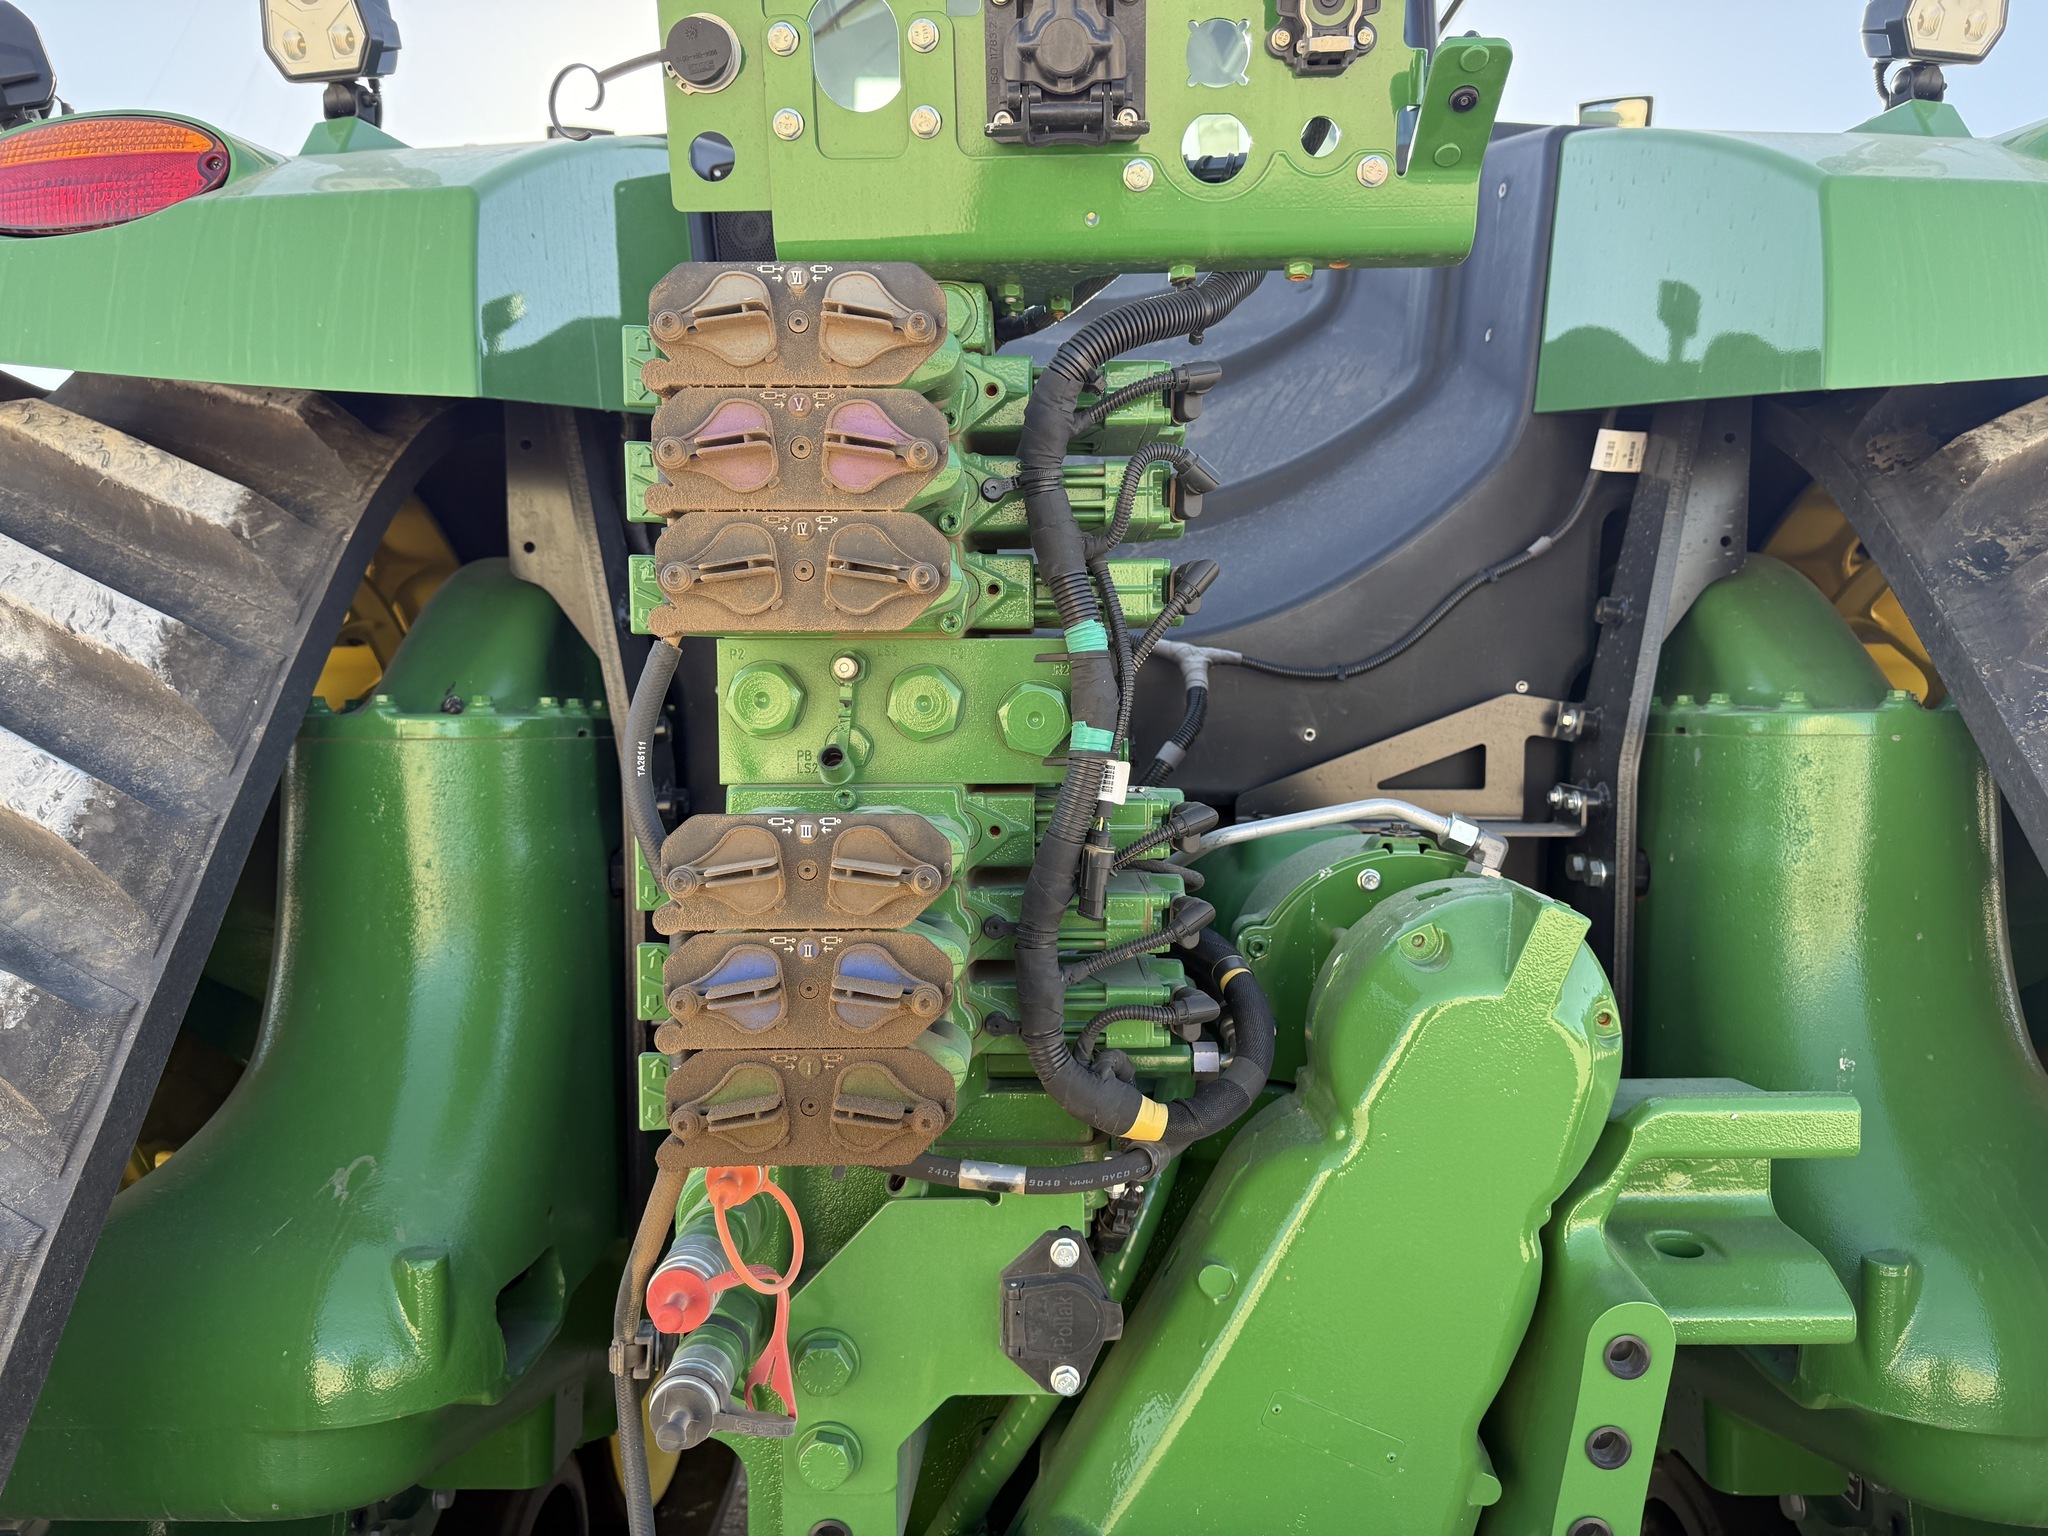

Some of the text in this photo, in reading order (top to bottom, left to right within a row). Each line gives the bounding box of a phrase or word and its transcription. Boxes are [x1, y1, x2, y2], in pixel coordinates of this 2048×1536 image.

[989, 20, 999, 85] ISO 11783-2
[791, 270, 803, 285] VI
[794, 397, 804, 411] V
[797, 522, 808, 535] IV
[729, 647, 746, 660] P2
[636, 741, 647, 778] TA26111
[796, 749, 813, 762] PB
[796, 762, 819, 775] LS2
[800, 824, 812, 838] III
[804, 944, 812, 957] II
[927, 1166, 959, 1179] 2407
[1053, 1295, 1073, 1349] Pollak
